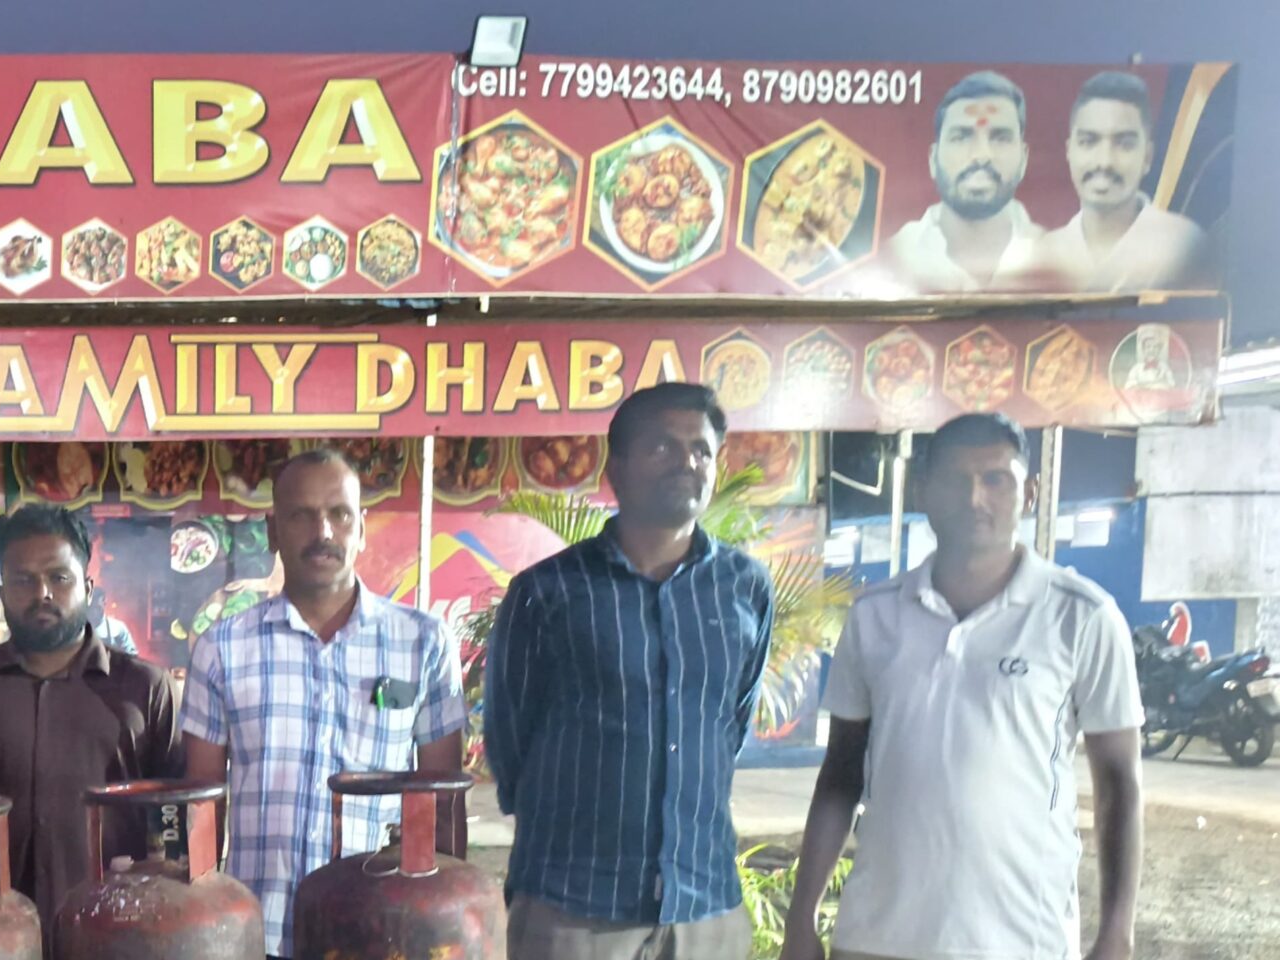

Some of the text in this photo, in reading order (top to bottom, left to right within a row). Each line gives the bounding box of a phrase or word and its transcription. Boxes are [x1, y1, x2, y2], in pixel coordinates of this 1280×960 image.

[451, 62, 923, 106] Cell: 7799423644, 8790982601
[355, 339, 687, 413] DHABA
